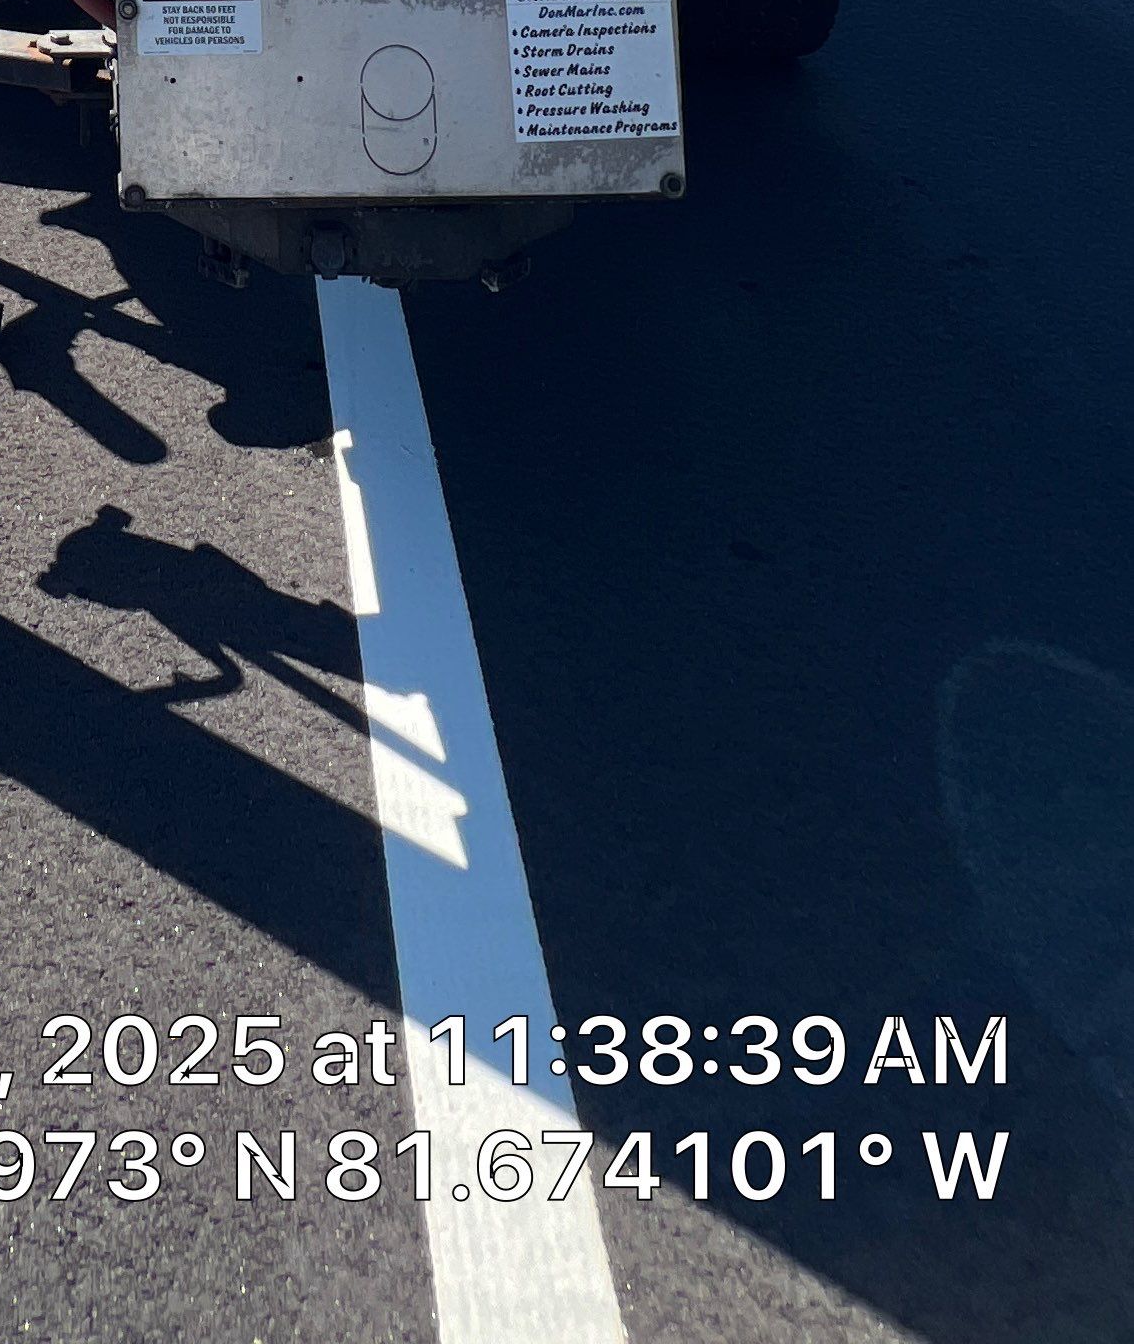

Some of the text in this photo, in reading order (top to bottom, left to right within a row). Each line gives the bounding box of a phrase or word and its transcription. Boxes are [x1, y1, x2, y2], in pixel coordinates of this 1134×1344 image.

[162, 5, 181, 14] STAY
[182, 5, 204, 14] BACK
[218, 5, 236, 14] FEET
[538, 4, 645, 19] DonMarInc.com
[163, 15, 236, 24] NOT RESPONSIBLE
[168, 25, 231, 35] FOR DAMAGE TO
[520, 22, 657, 40] Camera Inspections
[154, 36, 245, 46] VEHICLES OR PERSONS
[521, 43, 615, 58] Storm Drains
[522, 63, 611, 78] Sewer Mains
[524, 82, 614, 98] Root Cutting
[526, 100, 650, 117] Pressure Washing
[527, 120, 678, 137] Maintenance Programs
